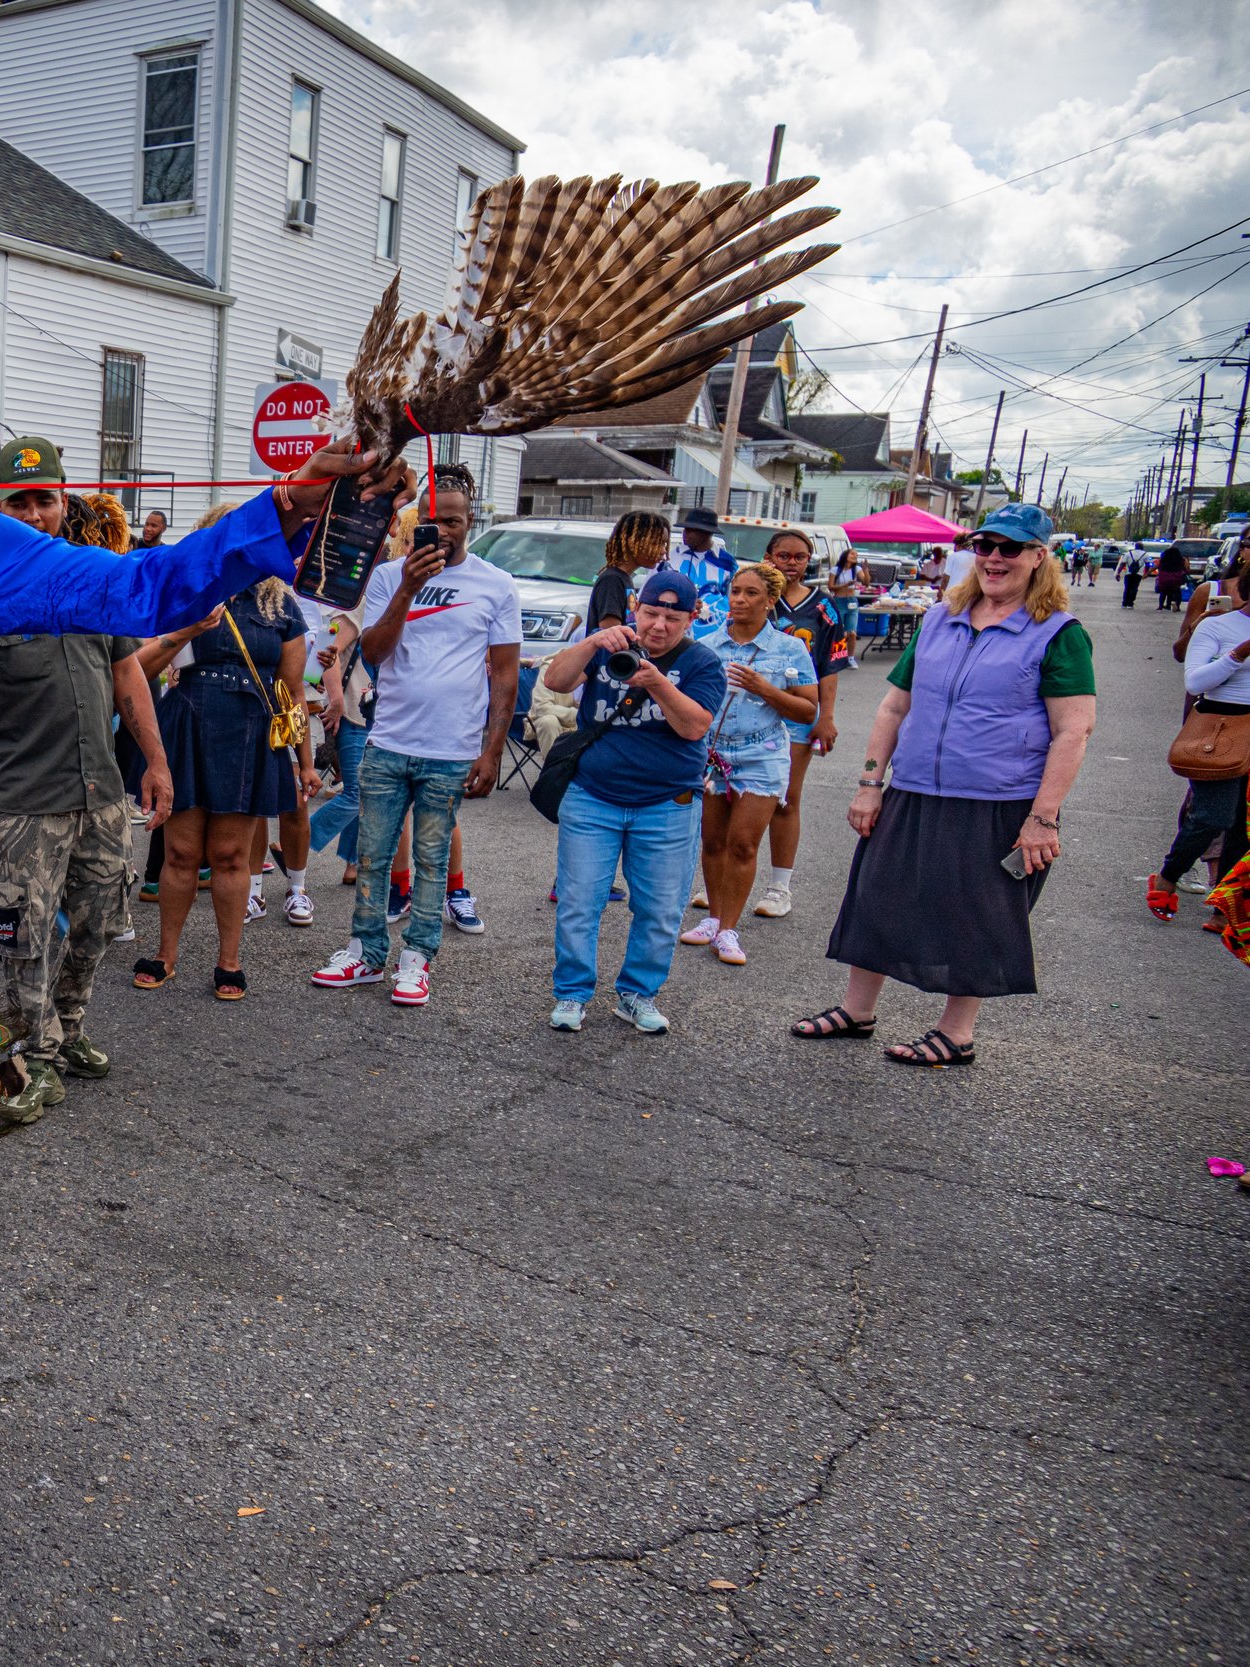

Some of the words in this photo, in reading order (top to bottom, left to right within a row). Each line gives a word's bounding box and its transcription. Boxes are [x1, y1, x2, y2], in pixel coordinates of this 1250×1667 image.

[290, 344, 304, 363] ONE
[304, 350, 320, 372] WAY
[266, 402, 286, 416] DO
[293, 399, 324, 415] NOT
[268, 440, 314, 456] ENTER
[414, 586, 460, 607] NIKE
